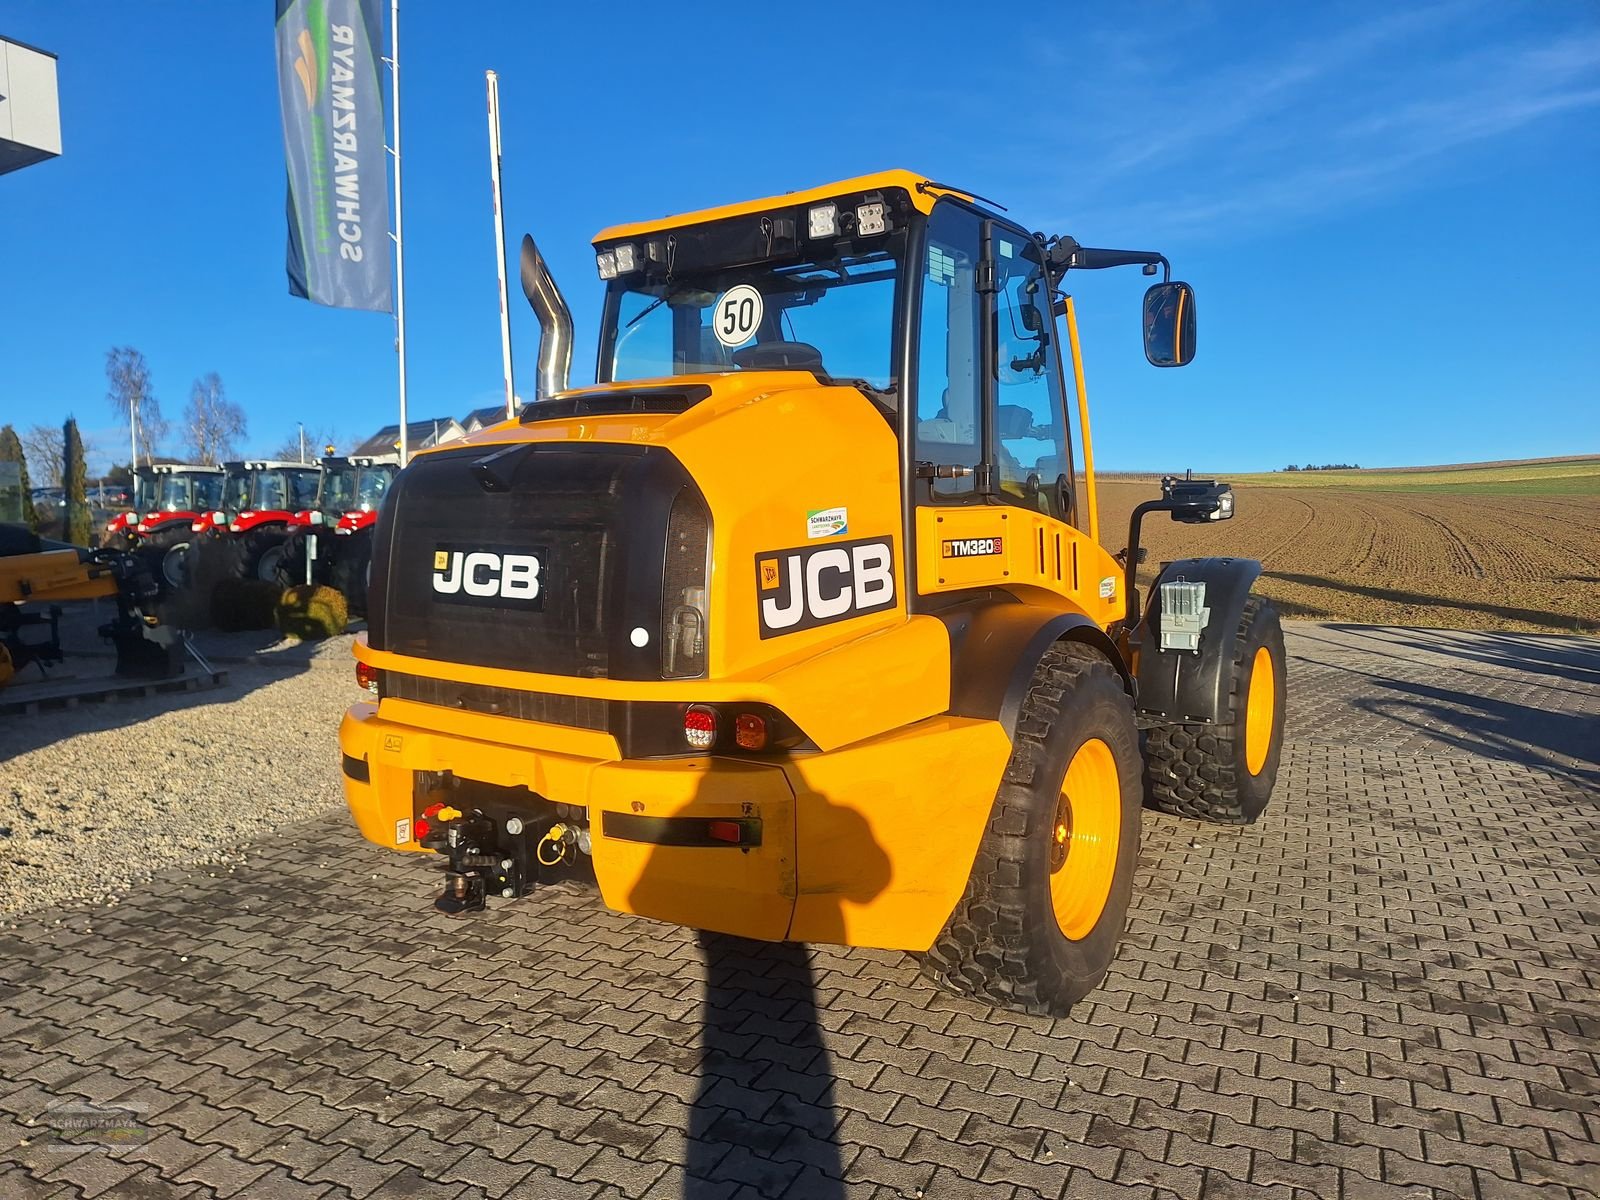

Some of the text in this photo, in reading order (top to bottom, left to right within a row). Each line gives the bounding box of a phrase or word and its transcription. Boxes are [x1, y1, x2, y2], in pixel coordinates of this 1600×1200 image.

[723, 297, 754, 335] 50
[432, 551, 540, 600] JCB
[762, 543, 894, 629] JCB
